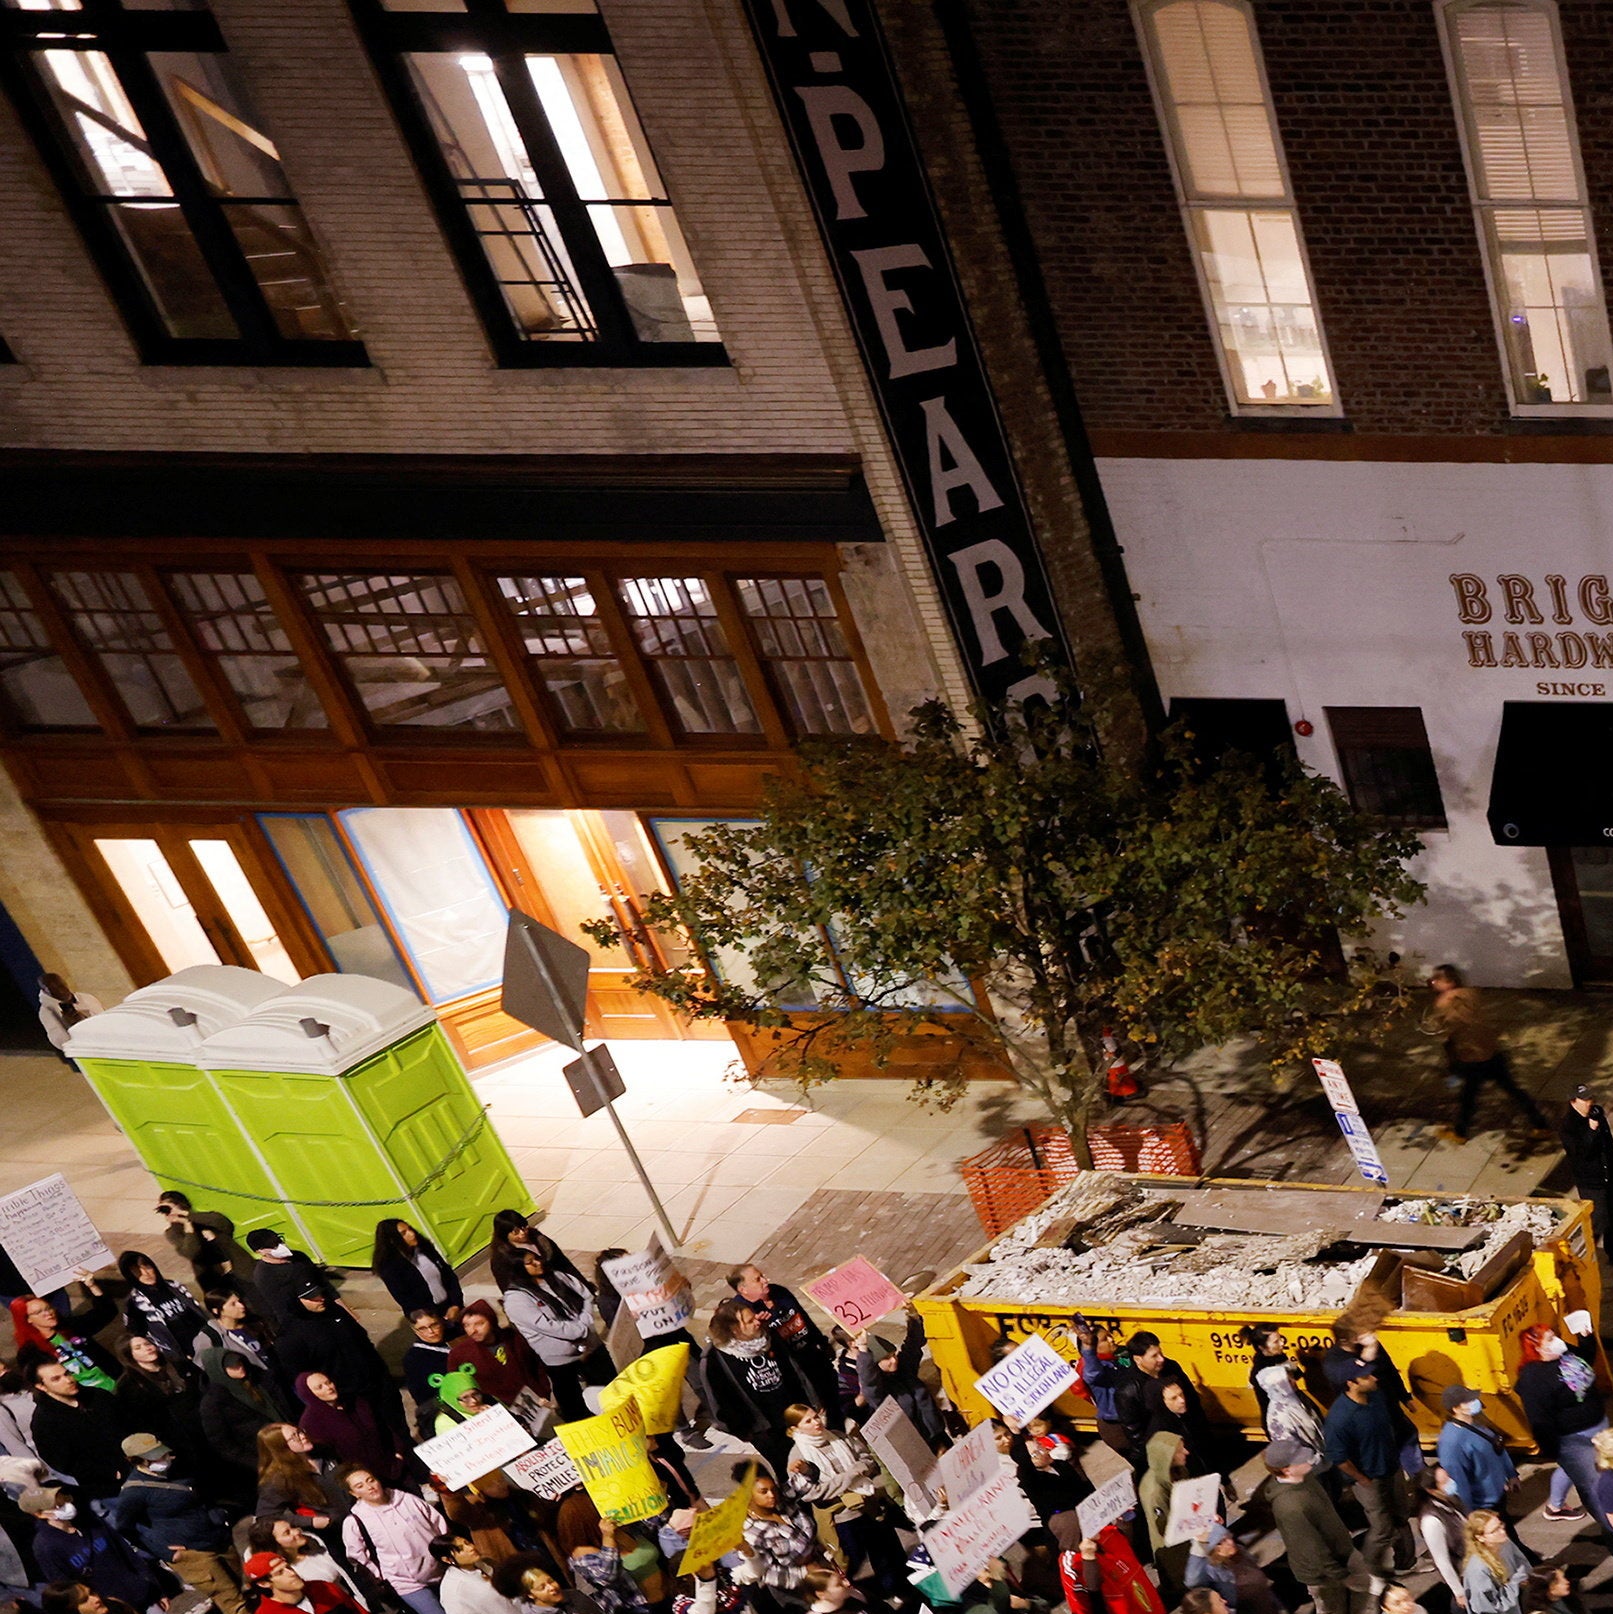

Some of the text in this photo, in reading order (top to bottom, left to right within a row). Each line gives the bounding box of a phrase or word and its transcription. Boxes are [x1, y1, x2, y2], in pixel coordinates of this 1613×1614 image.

[1536, 681, 1606, 698] SINCE
[29, 1173, 68, 1204] Things
[639, 1305, 666, 1320] PUT
[652, 1315, 675, 1330] ON
[832, 1292, 872, 1331] 32
[979, 1345, 1040, 1400] NO ONE
[997, 1353, 1061, 1411] IS ILLEGAL
[1021, 1377, 1056, 1409] STOLEN
[1046, 1361, 1074, 1387] LAND
[419, 1425, 468, 1463] Staying
[461, 1410, 494, 1436] Silent
[566, 1415, 615, 1452] THEY
[513, 1449, 551, 1475] ABOLISH
[526, 1452, 574, 1485] PROTECT
[529, 1462, 584, 1503] FAMILIES
